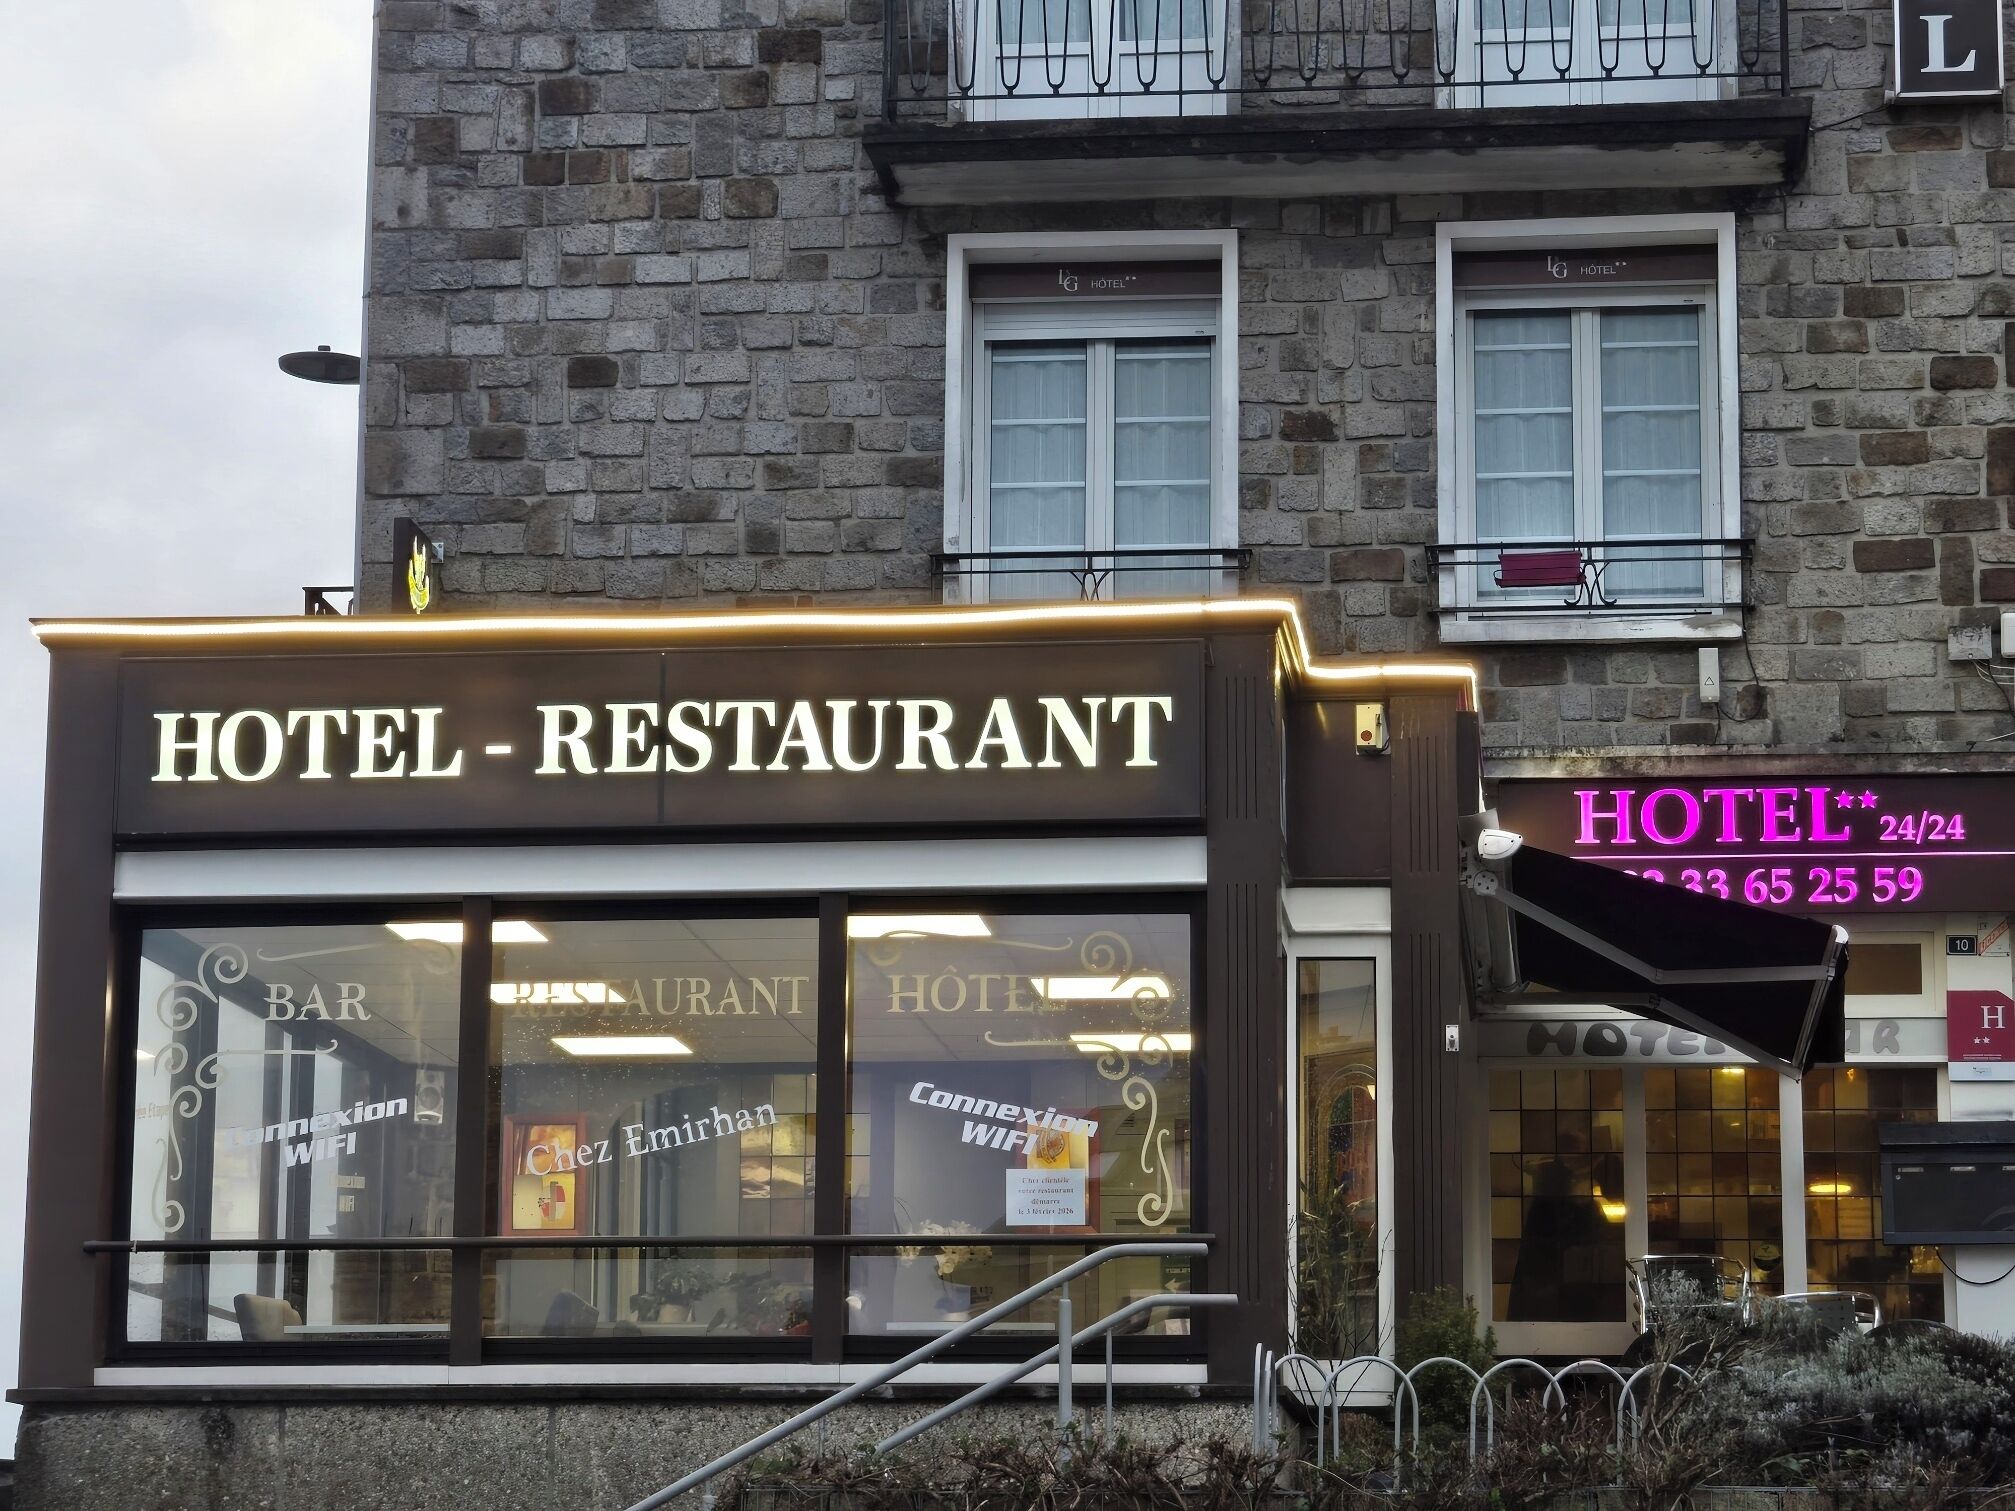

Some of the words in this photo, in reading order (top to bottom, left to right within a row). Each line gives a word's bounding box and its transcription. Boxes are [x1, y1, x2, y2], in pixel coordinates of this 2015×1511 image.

[151, 707, 463, 783] HOTEL
[535, 696, 1174, 775] RESTAURANT
[1573, 787, 1850, 845] HOTEL
[1879, 811, 1966, 845] 24/24
[1744, 868, 1794, 904] 65
[1808, 867, 1859, 903] 25
[1873, 866, 1924, 902] 59
[1955, 939, 1969, 951] 10
[263, 983, 372, 1021] BAR
[510, 976, 810, 1018] RESTAURANT
[1980, 1005, 2006, 1029] H
[908, 1081, 1099, 1138] Connexion
[526, 1137, 613, 1177] Chez
[621, 1102, 779, 1158] Emirhan
[960, 1120, 1039, 1155] WIFI
